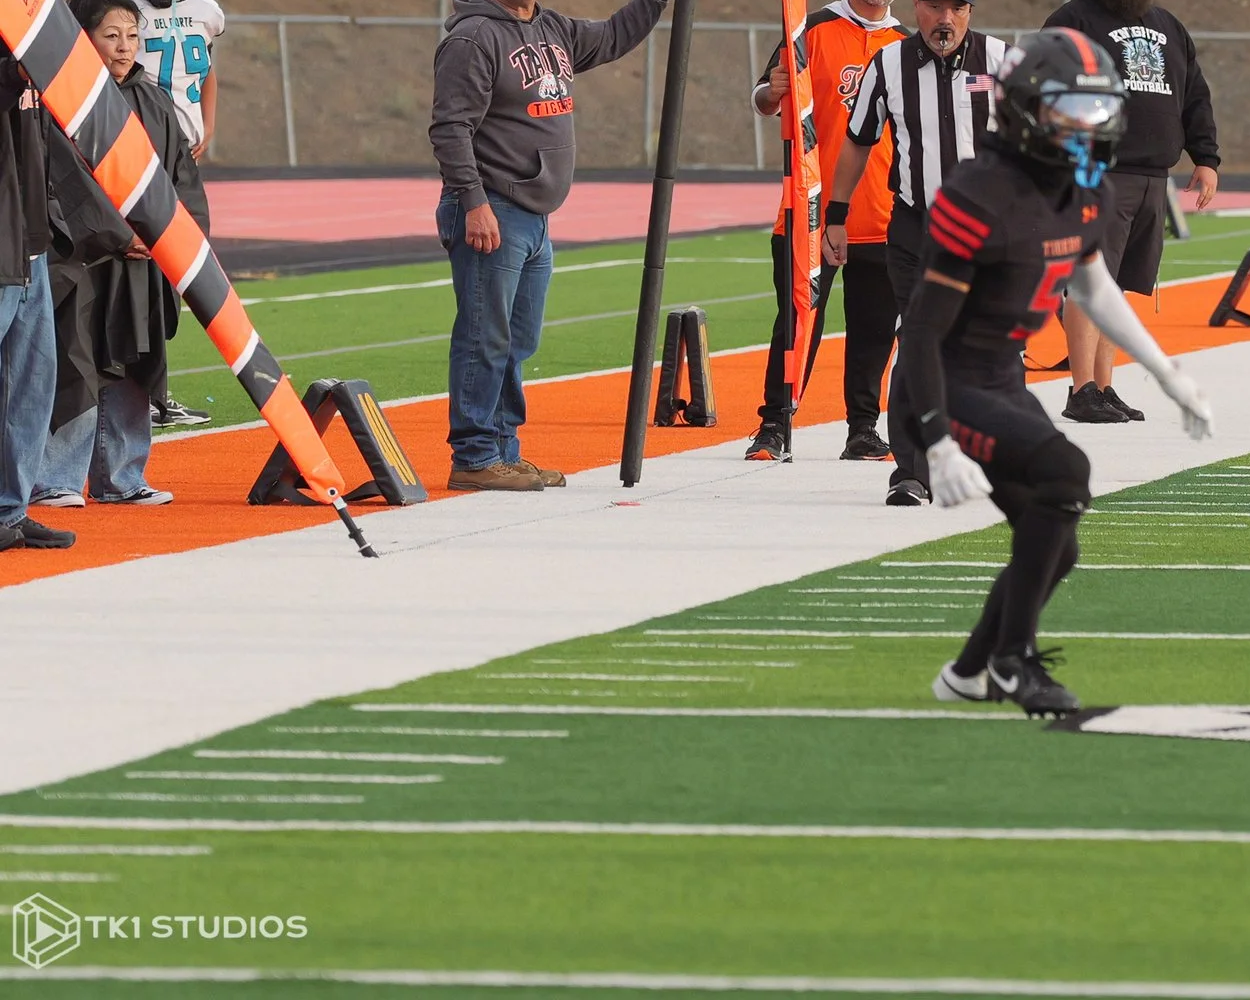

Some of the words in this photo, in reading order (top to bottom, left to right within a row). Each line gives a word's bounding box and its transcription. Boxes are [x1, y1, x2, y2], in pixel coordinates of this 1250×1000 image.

[154, 18, 168, 29] DEL
[1108, 26, 1167, 46] KNGHTS
[145, 34, 211, 104] 79
[509, 41, 574, 90] TAOS
[1123, 79, 1173, 96] FOOTBALL
